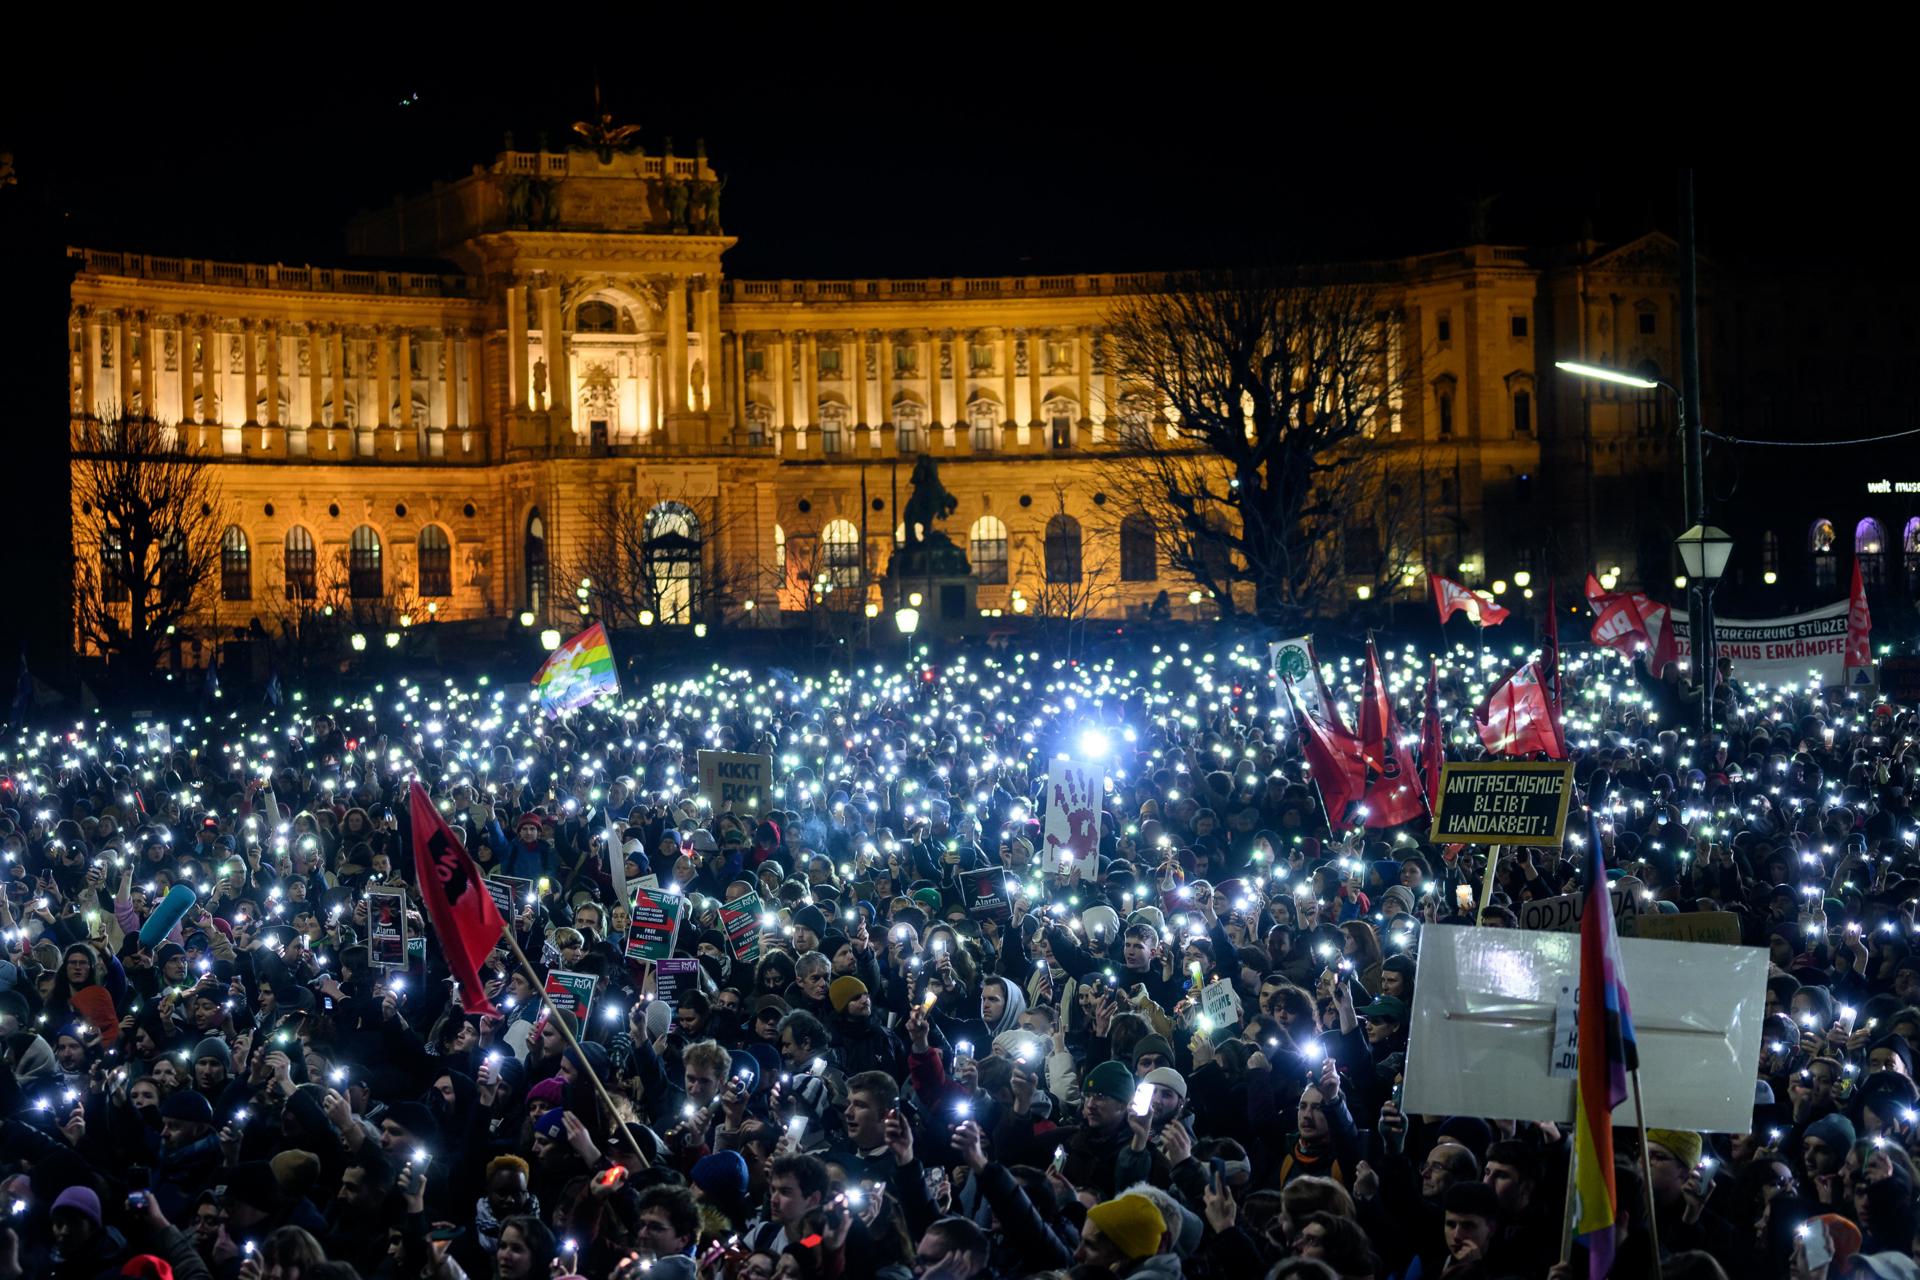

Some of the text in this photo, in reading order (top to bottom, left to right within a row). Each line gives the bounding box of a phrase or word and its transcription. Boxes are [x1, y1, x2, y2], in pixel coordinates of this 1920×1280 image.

[1867, 479, 1892, 493] welt
[1766, 637, 1849, 659] ERKÄMPFE
[1446, 775, 1564, 794] ANTIFASCHISMUS
[1474, 795, 1530, 813] BLEIBT
[975, 897, 1001, 907] Alarm
[375, 925, 397, 935] Alarm
